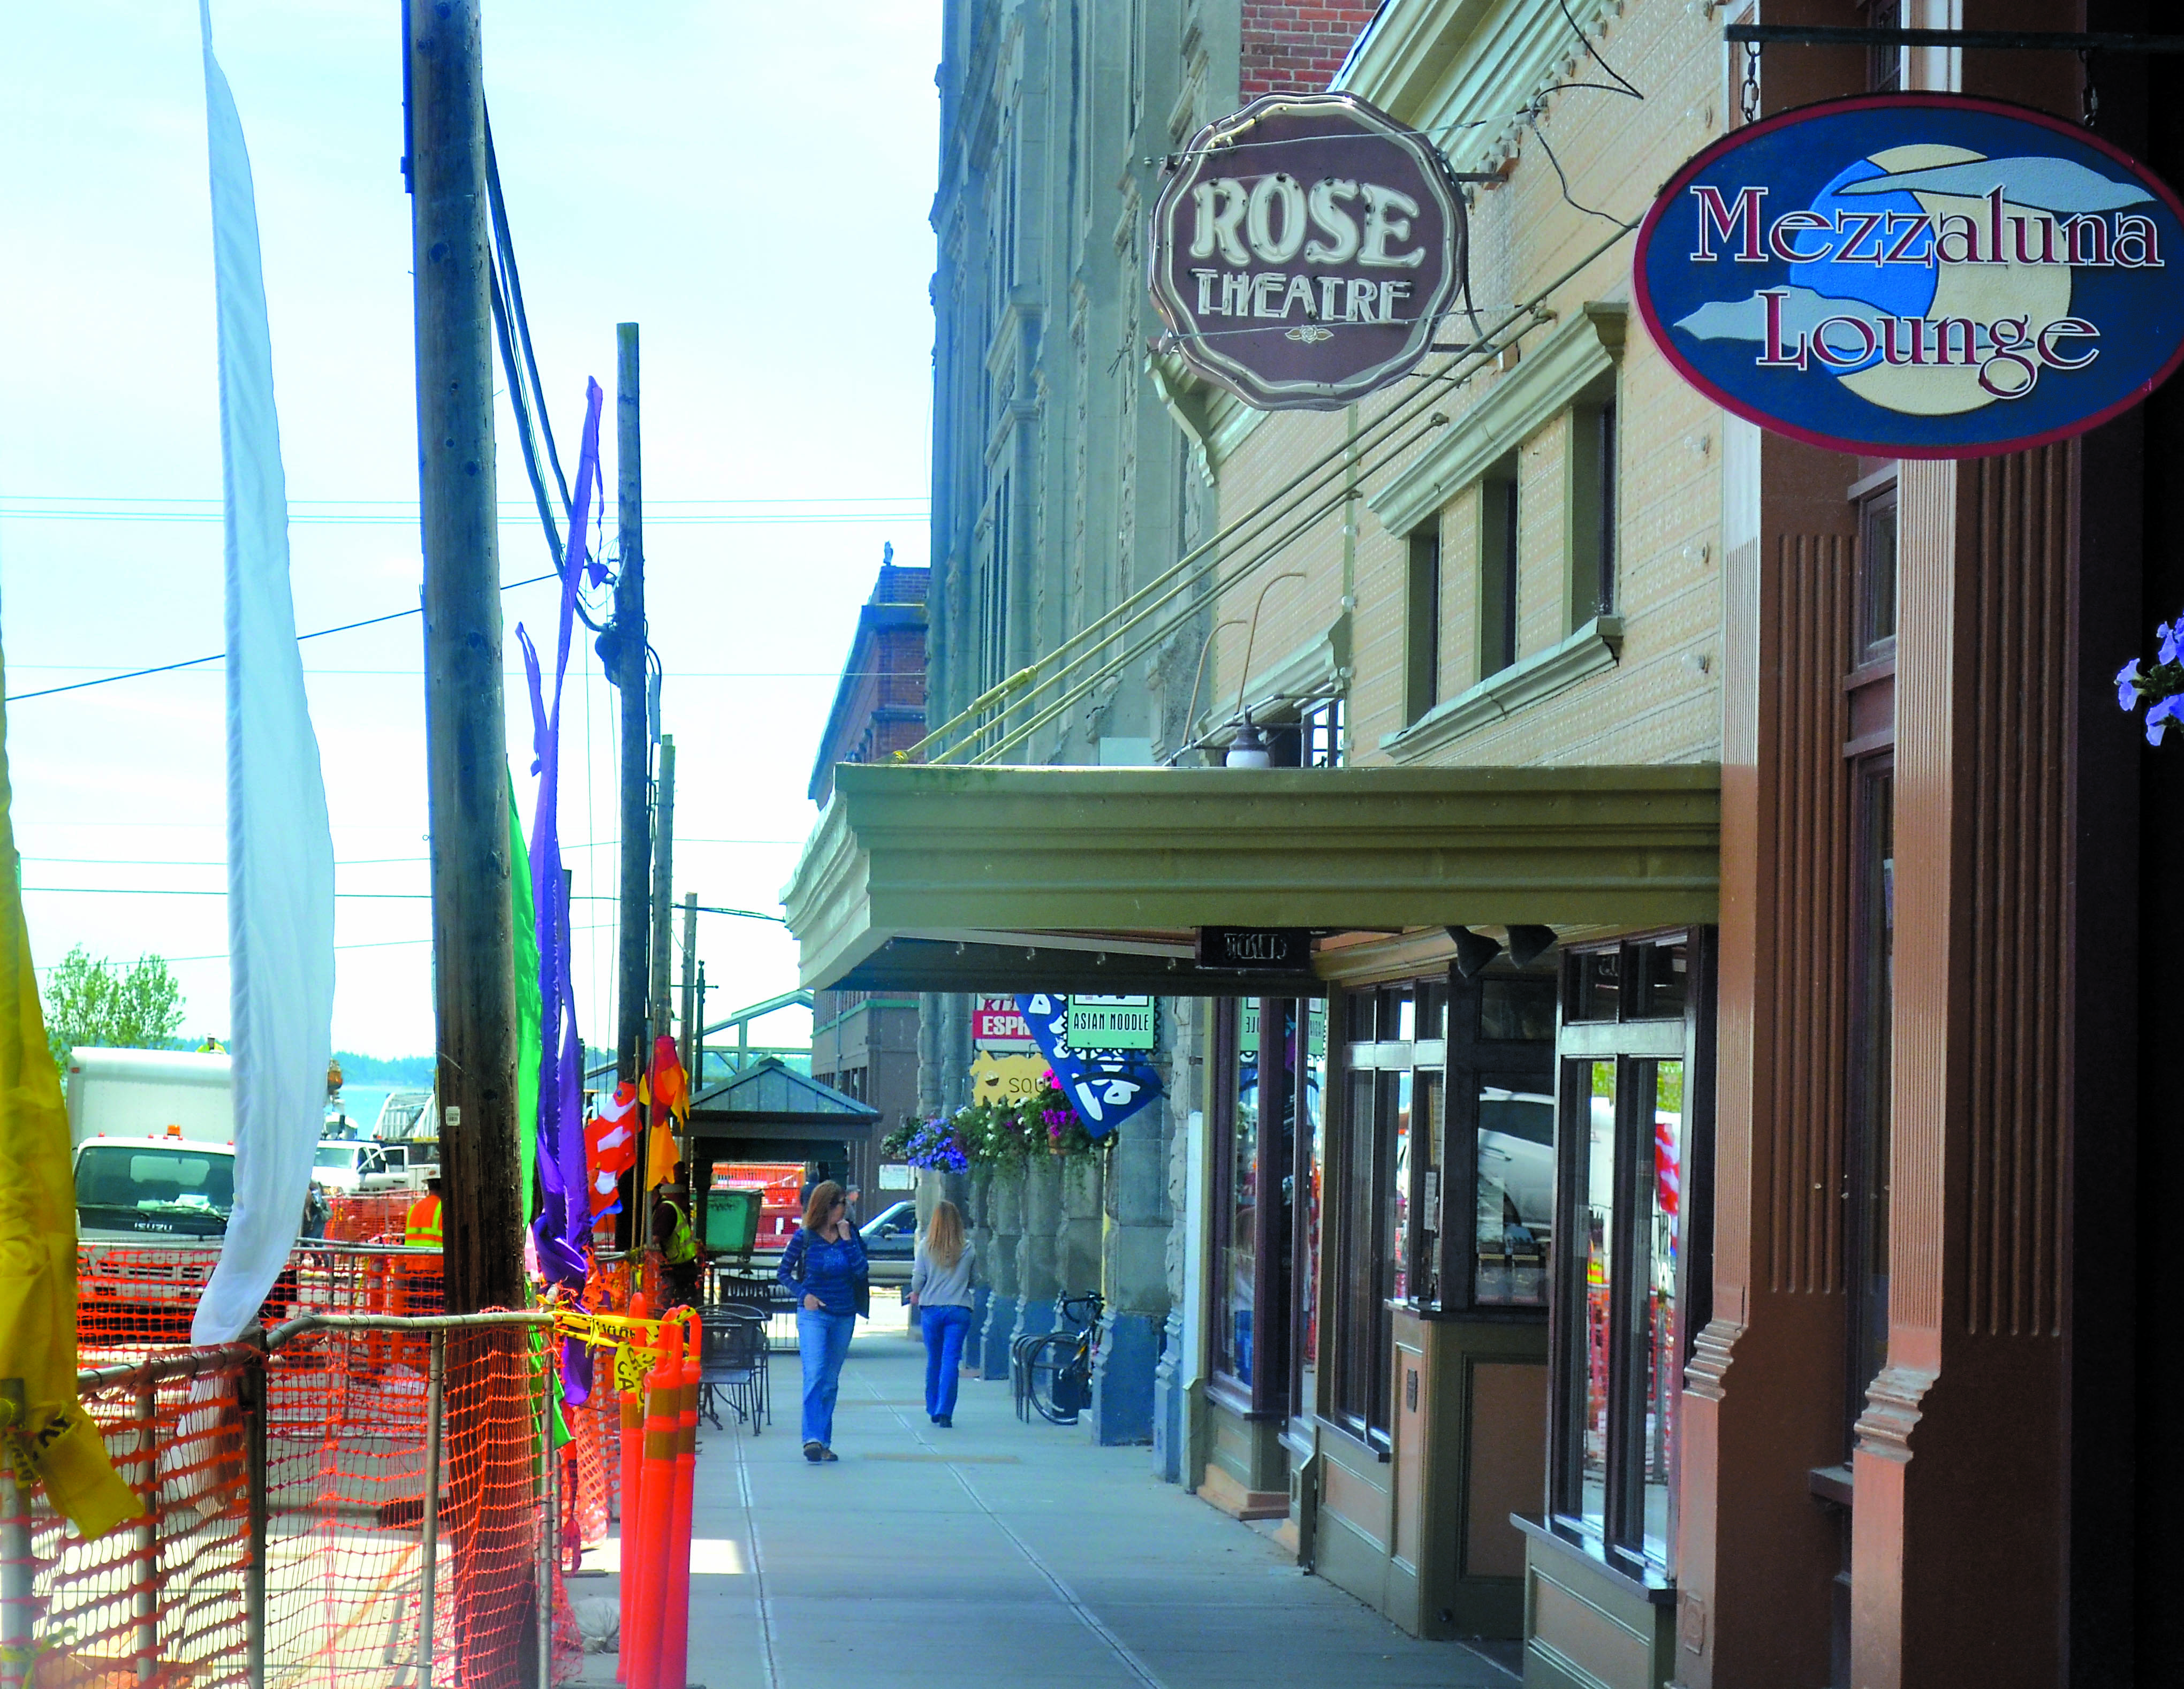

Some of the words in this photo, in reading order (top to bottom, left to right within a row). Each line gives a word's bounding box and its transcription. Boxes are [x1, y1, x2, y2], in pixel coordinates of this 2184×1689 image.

[1189, 173, 1426, 267] ROSE
[1690, 185, 2165, 268] Mezzaluna
[1188, 268, 1413, 324] THEATRE
[1755, 289, 2100, 400] Lounge
[1074, 1013, 1104, 1030] ASIAN
[1110, 1013, 1149, 1031] NOODLE
[134, 1222, 172, 1231] ISUZU
